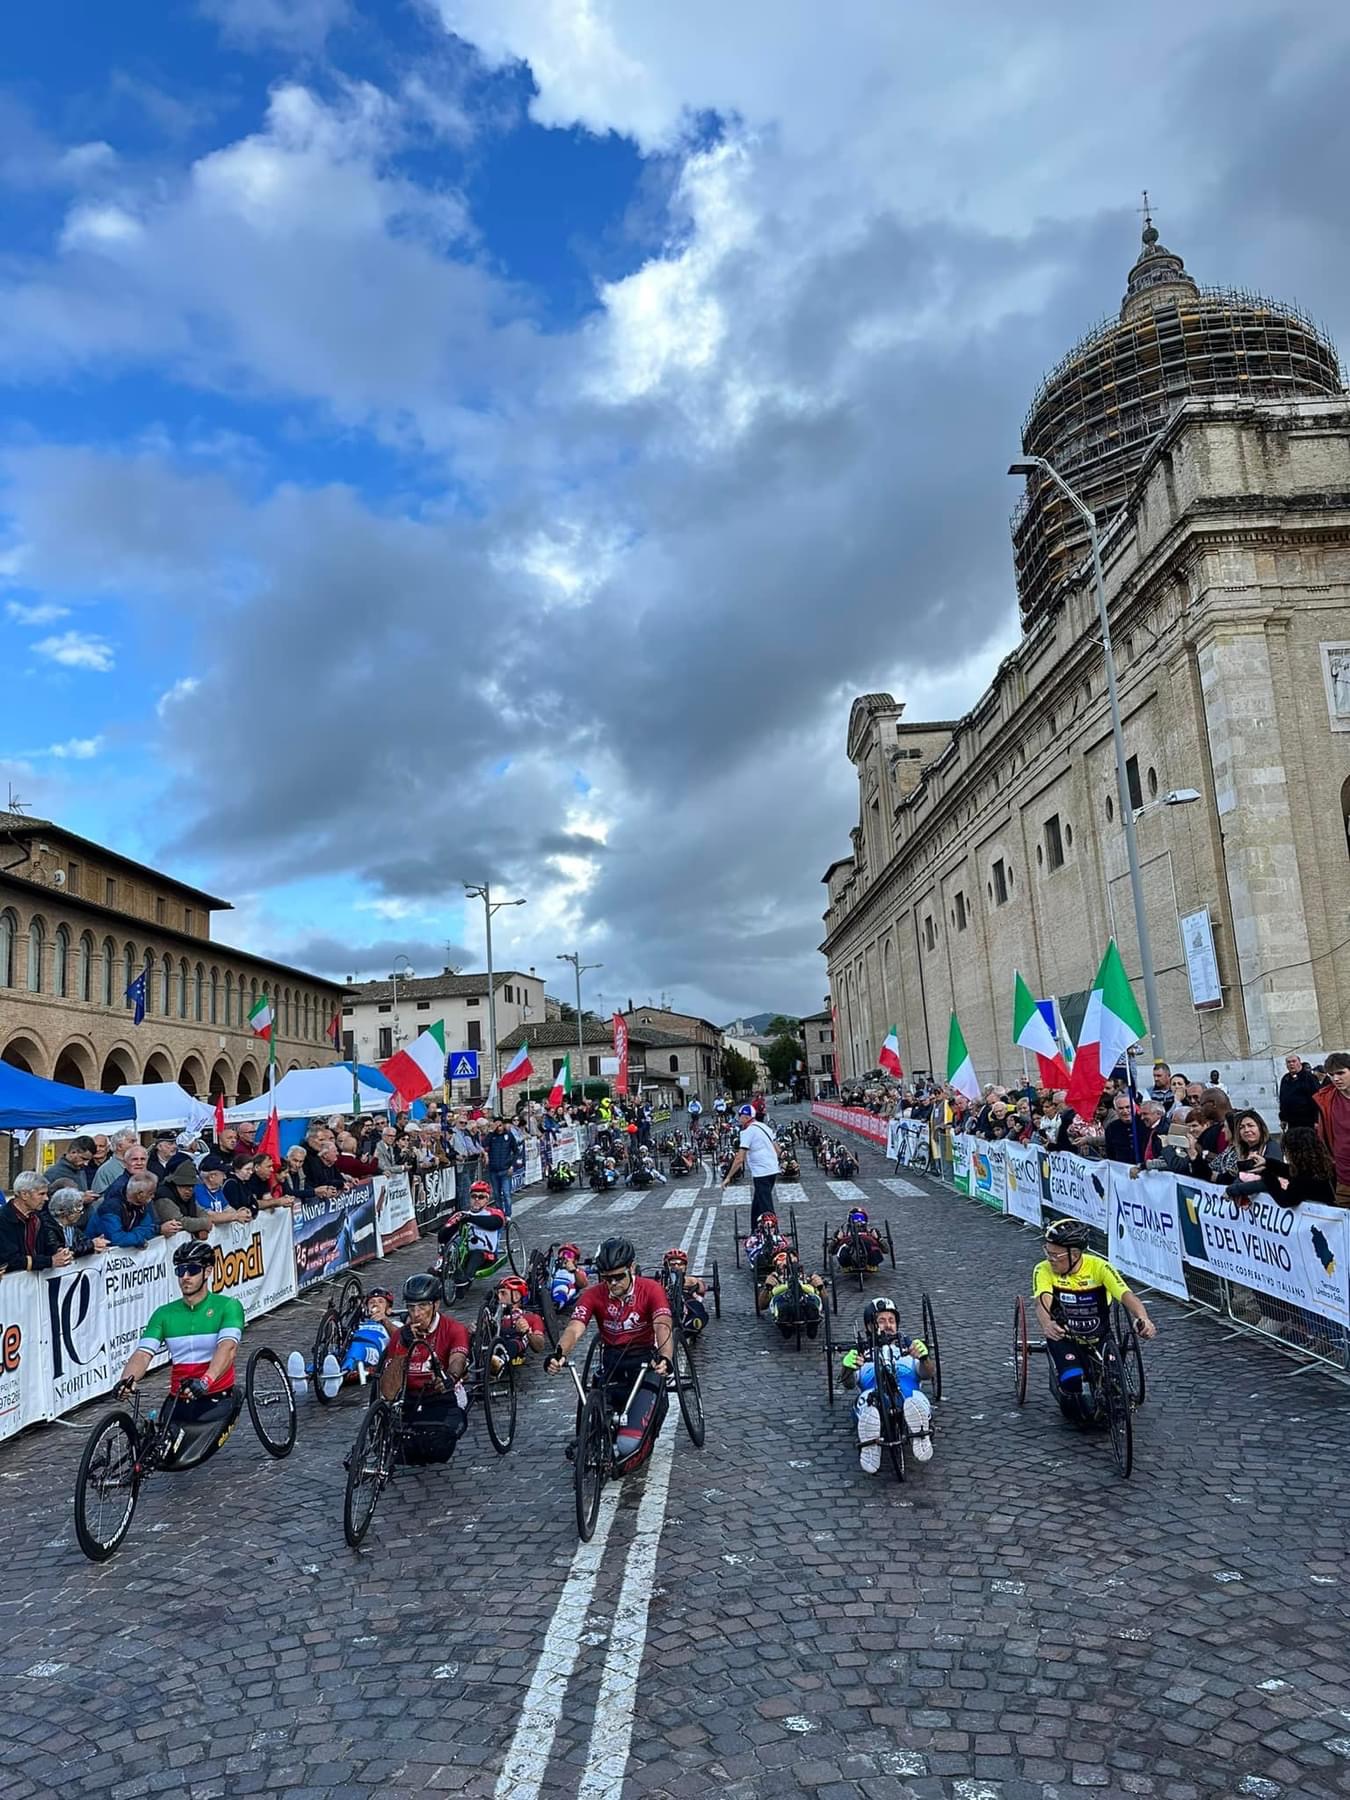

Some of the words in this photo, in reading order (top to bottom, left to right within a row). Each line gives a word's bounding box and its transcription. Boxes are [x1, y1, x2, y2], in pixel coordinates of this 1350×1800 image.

[1204, 1192, 1226, 1220] BCC
[1248, 1200, 1295, 1236] SPELLO
[106, 1256, 137, 1274] AGENZIA
[212, 1231, 264, 1294] Dondi
[296, 1244, 308, 1268] 25
[1204, 1223, 1214, 1247] E
[1214, 1226, 1242, 1255] DEL
[1242, 1232, 1292, 1272] VELINO
[106, 1276, 120, 1295] PC
[121, 1262, 167, 1290] INFORTUNI
[1210, 1256, 1234, 1272] CREDITO
[1235, 1264, 1275, 1287] COOPERATIVO
[1276, 1277, 1306, 1298] ITALIANO
